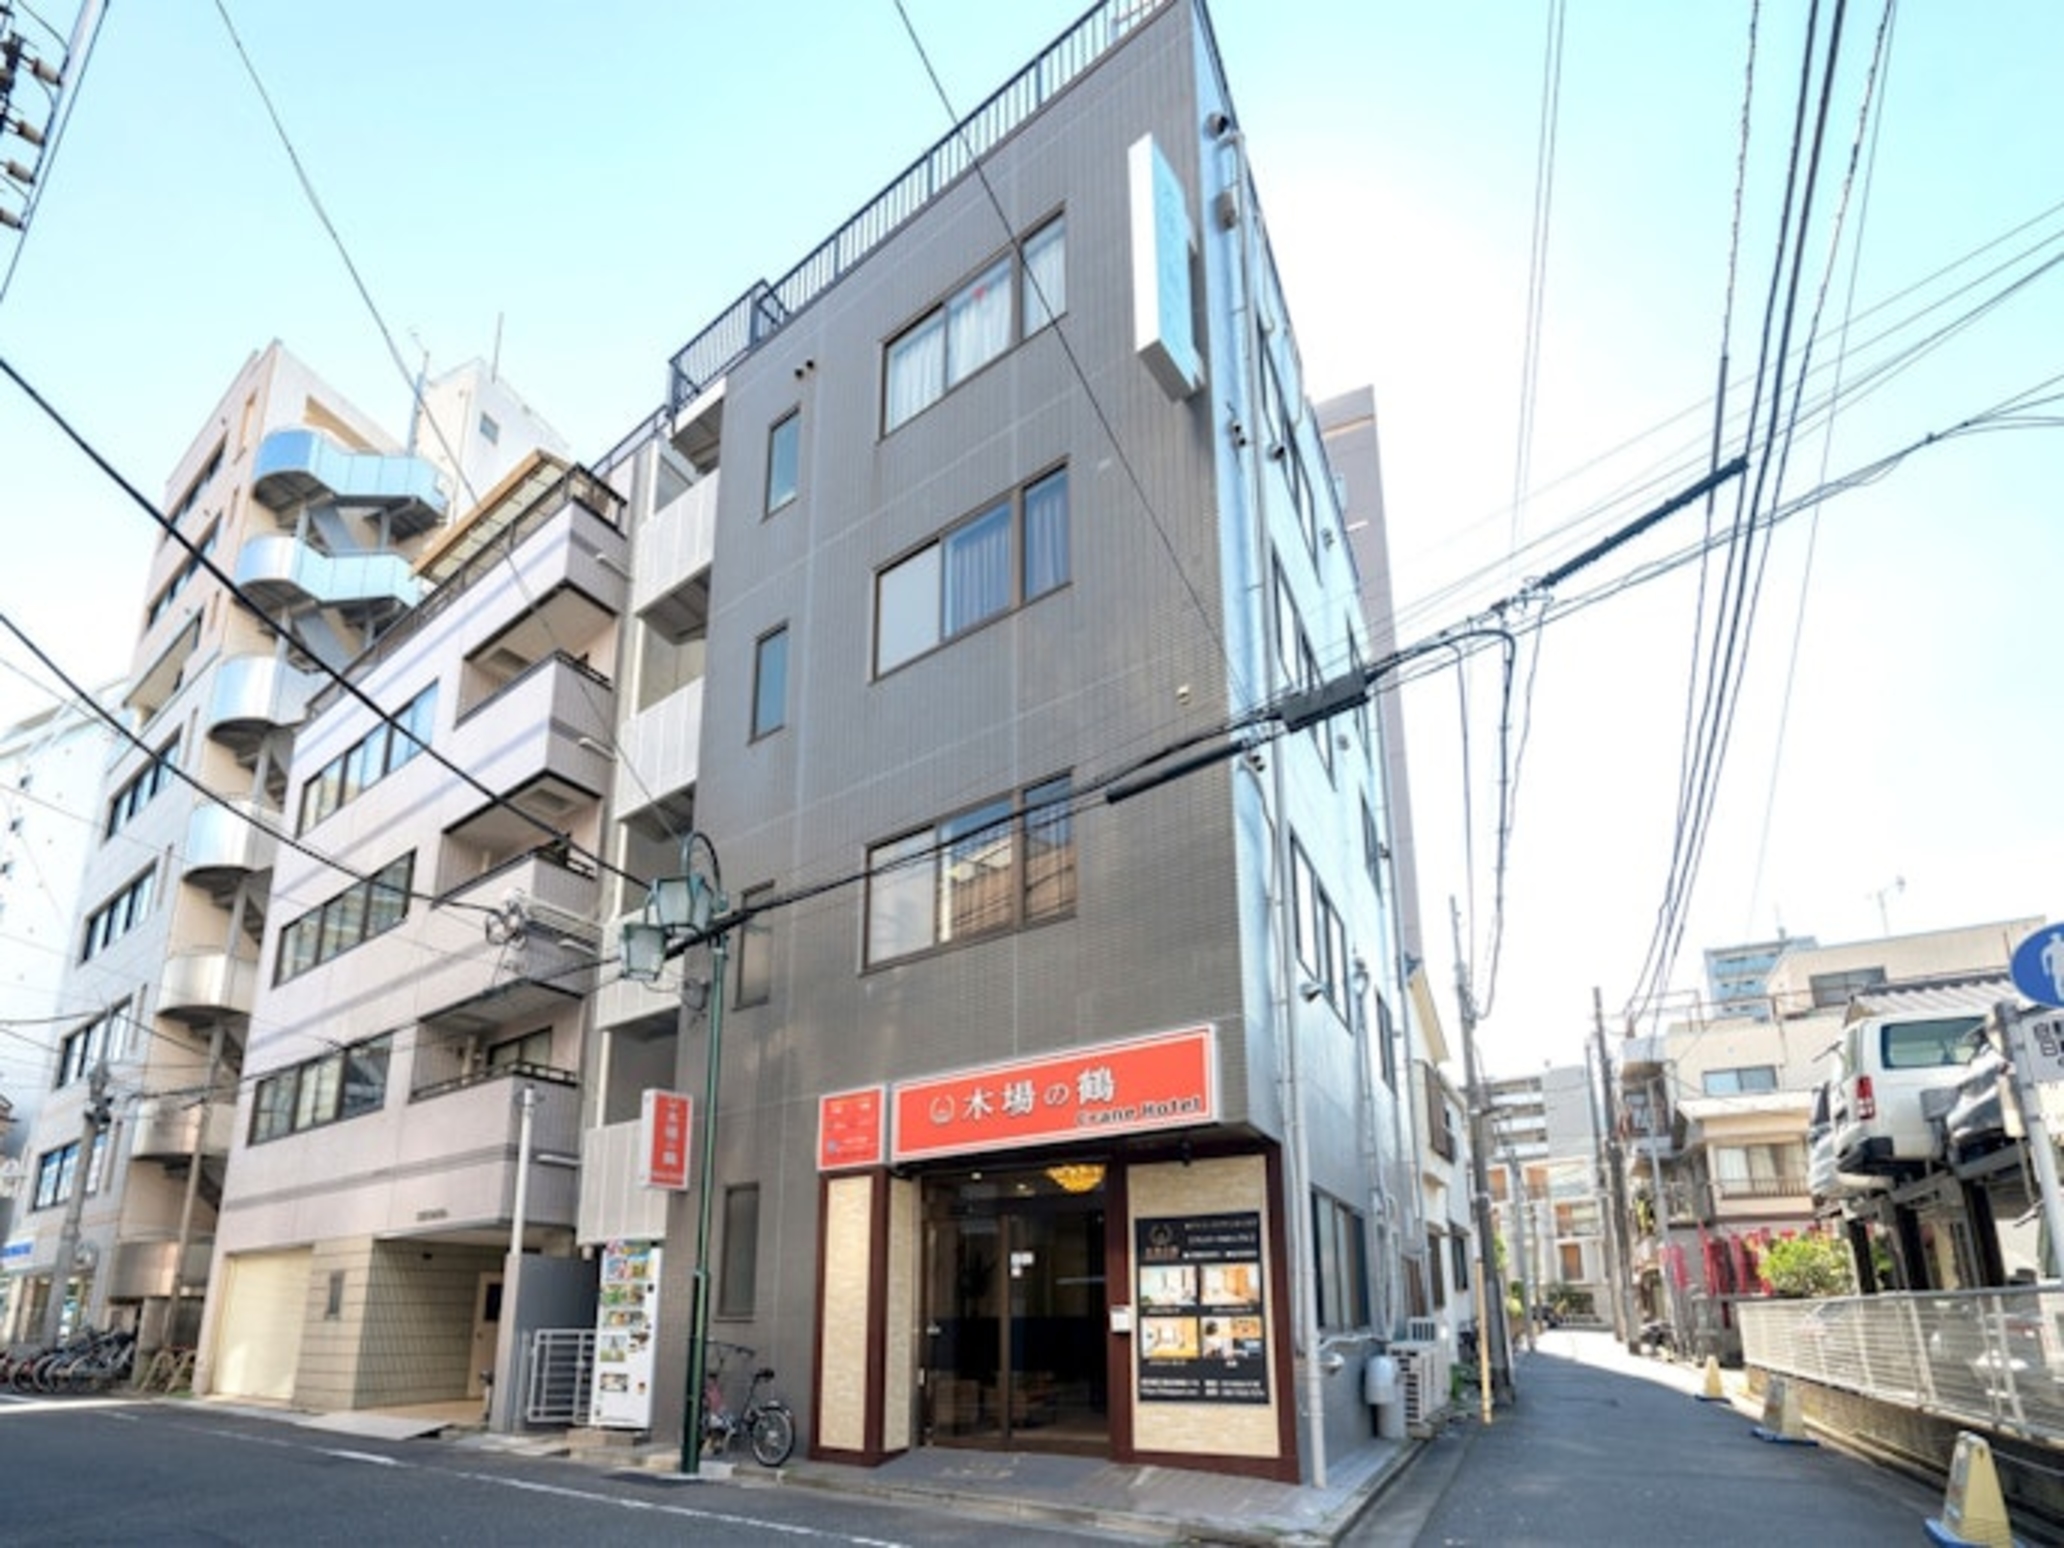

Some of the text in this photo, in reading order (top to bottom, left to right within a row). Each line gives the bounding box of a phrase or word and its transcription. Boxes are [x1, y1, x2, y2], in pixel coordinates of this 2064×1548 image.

[965, 1067, 1115, 1120] 木場の鶴
[1078, 1097, 1200, 1126] Crane Hotel
